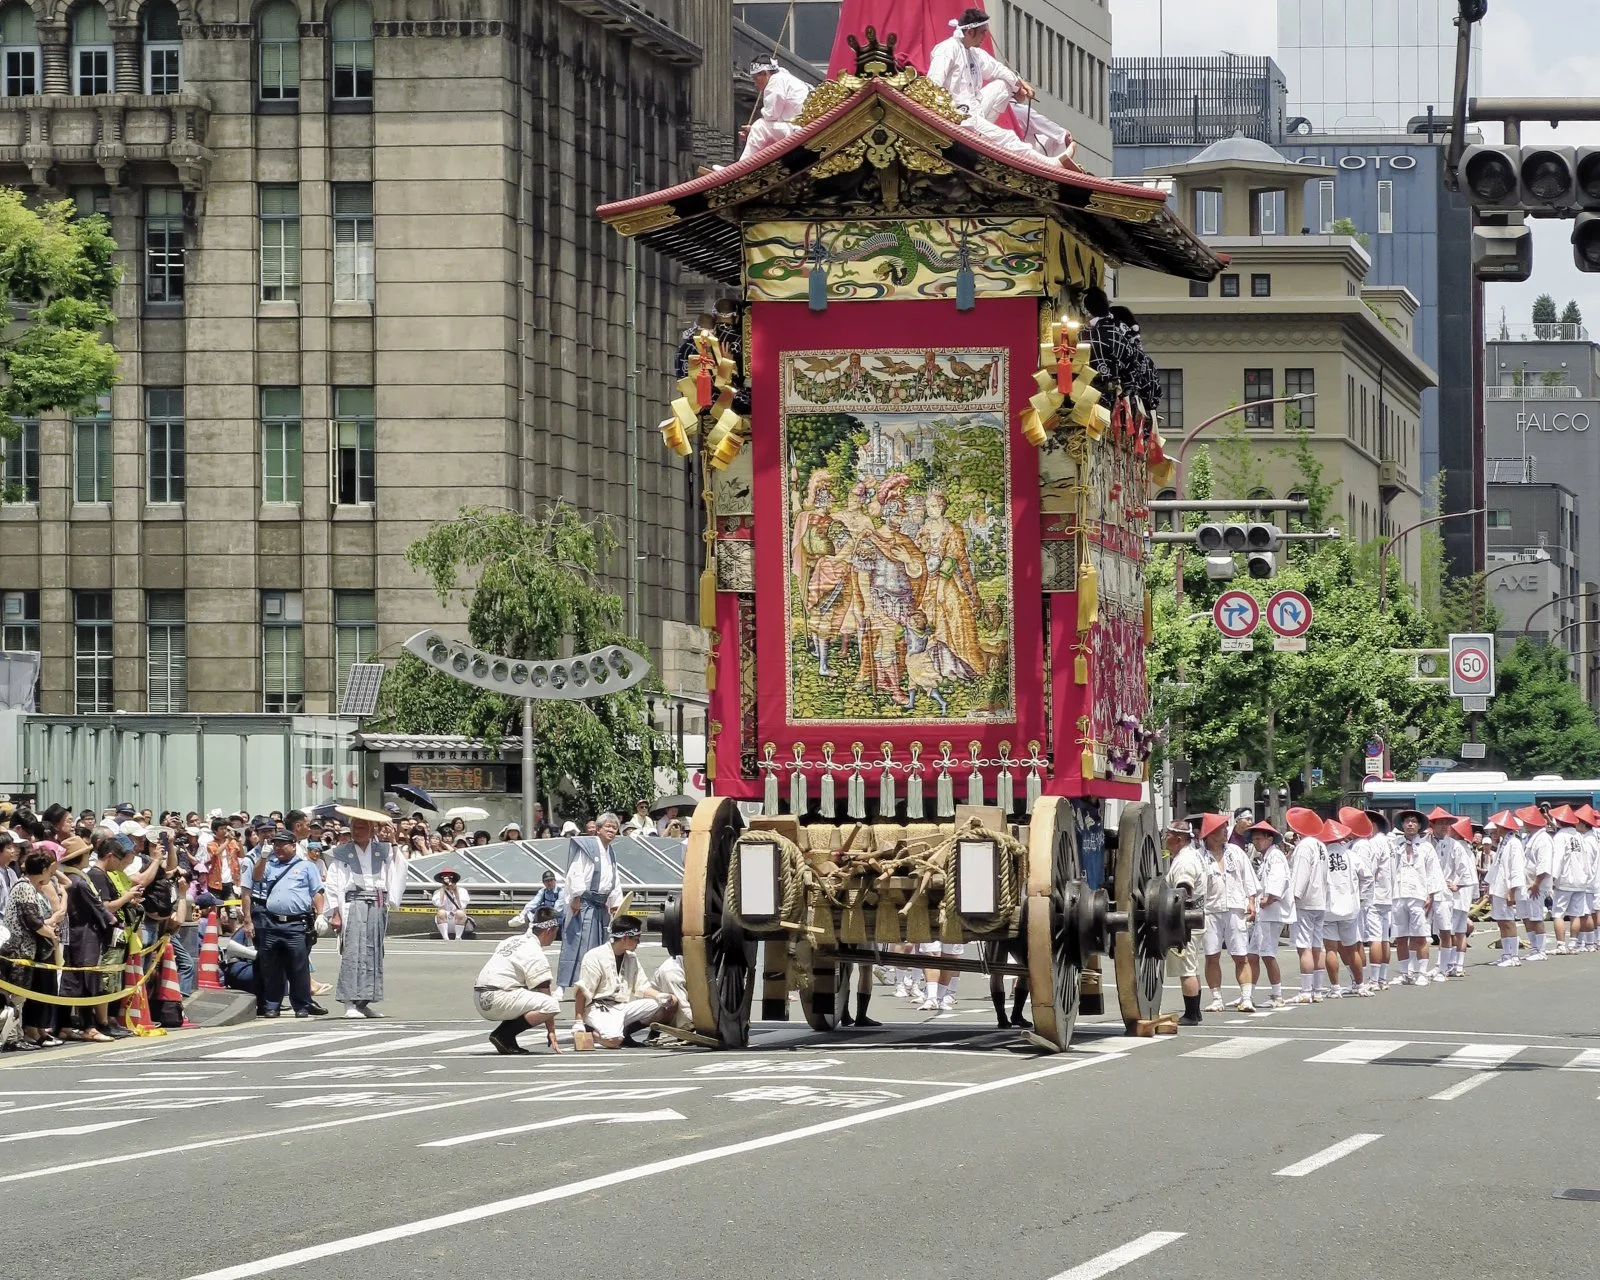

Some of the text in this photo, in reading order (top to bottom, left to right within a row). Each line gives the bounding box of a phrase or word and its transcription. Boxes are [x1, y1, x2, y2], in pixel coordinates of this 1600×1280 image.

[1516, 412, 1590, 432] FALCO
[1495, 576, 1538, 592] AXE
[1223, 641, 1251, 649] ここから
[1462, 658, 1481, 673] 50
[415, 750, 502, 761] 京都市役所掲示
